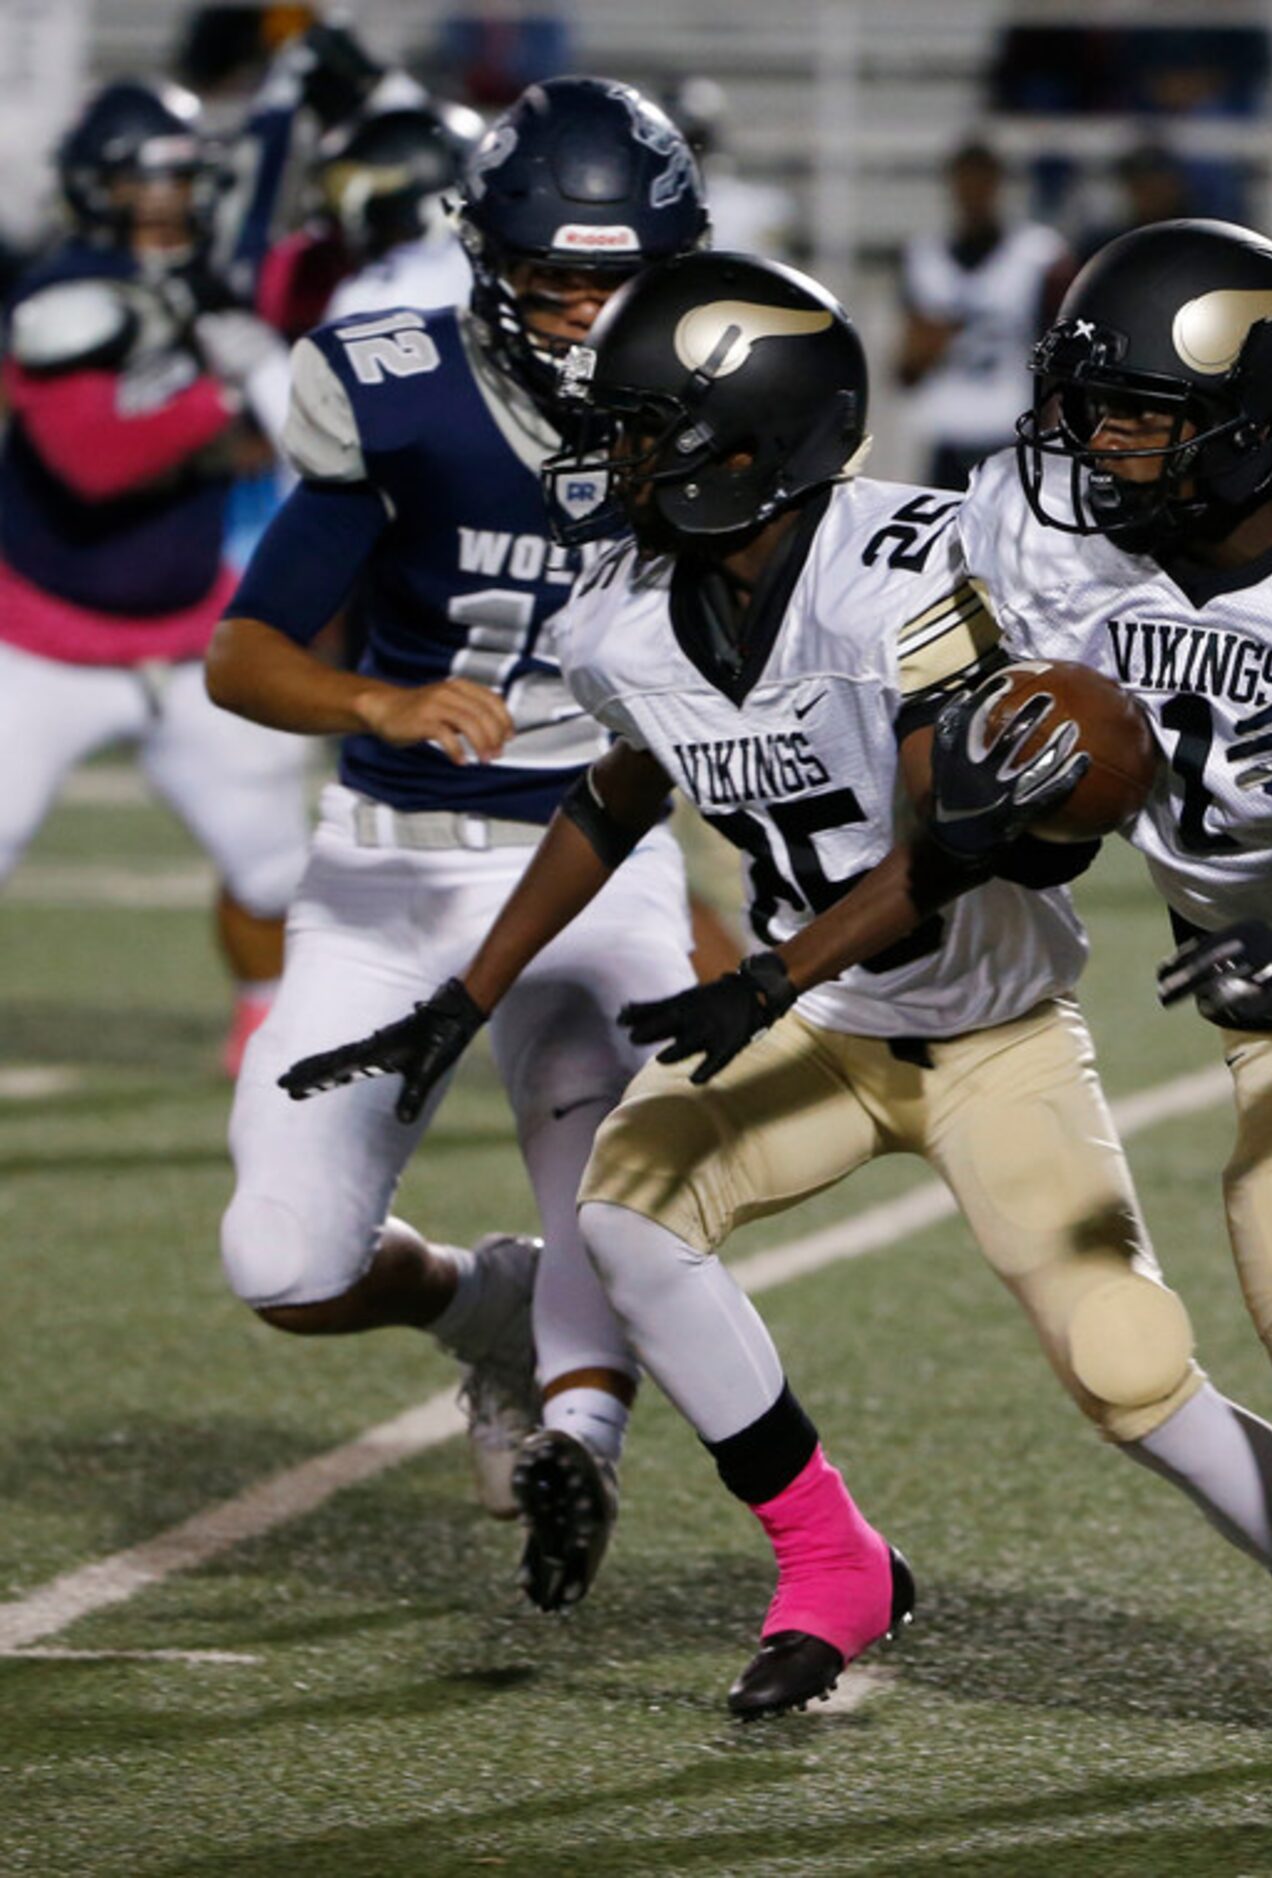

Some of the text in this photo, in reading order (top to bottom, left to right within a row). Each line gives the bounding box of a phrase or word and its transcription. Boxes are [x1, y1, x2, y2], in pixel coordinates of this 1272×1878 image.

[334, 312, 441, 384] 12
[862, 494, 961, 573] 25
[673, 732, 831, 804] VIKINGS
[1160, 692, 1243, 852] 1
